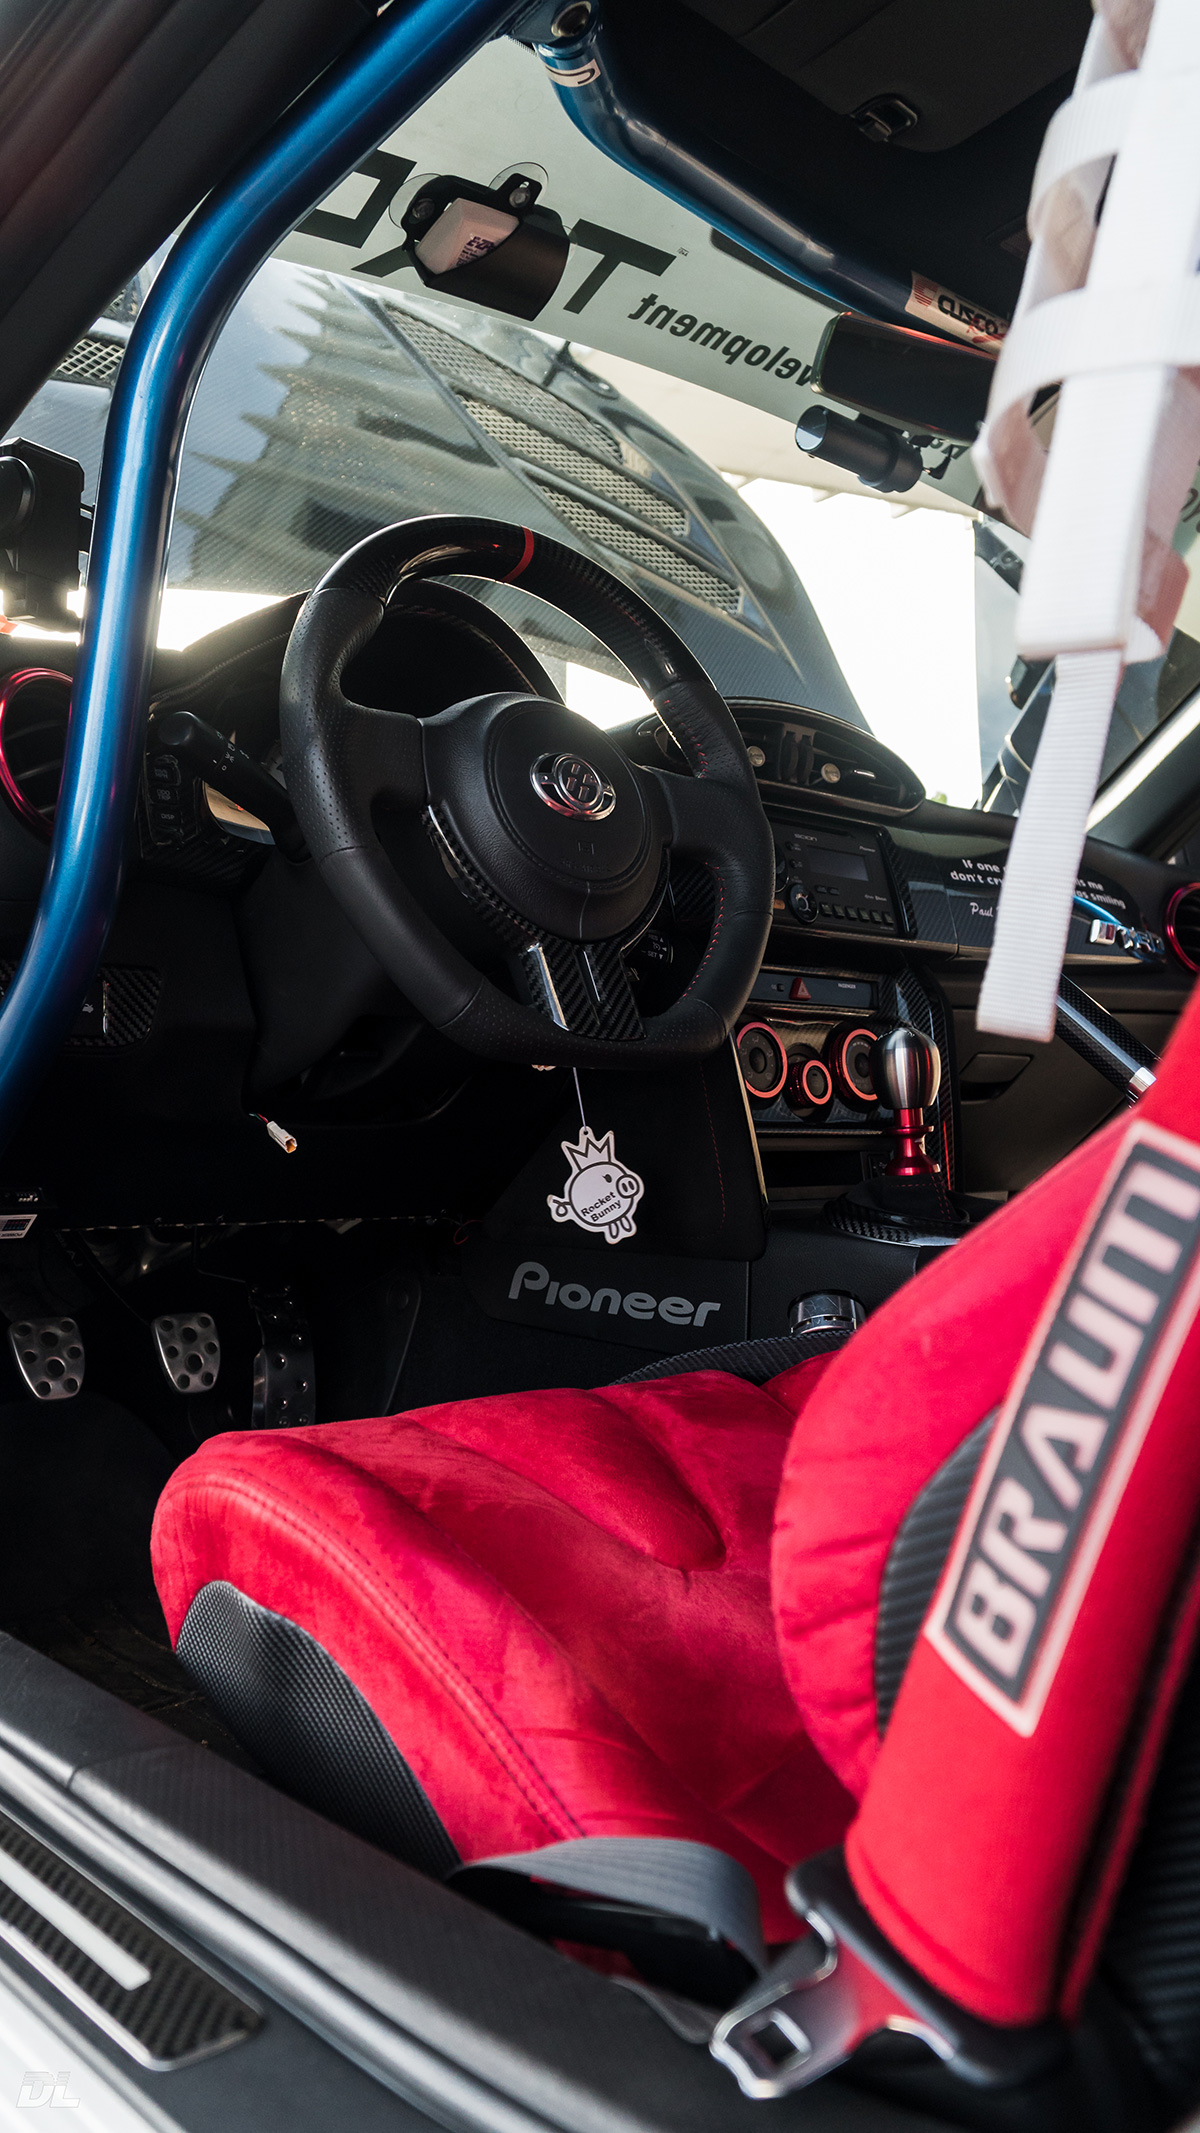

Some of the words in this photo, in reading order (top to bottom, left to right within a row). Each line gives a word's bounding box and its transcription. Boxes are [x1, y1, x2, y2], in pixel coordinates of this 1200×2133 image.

[937, 294, 999, 335] CUSCO
[976, 861, 1001, 873] one
[950, 869, 984, 884] don't
[1090, 892, 1126, 910] smiling
[969, 901, 994, 918] Paul
[580, 1191, 617, 1217] Rocket
[590, 1199, 622, 1223] Bunny
[508, 1261, 722, 1328] Pioneer
[951, 1159, 1200, 1681] BRAUM
